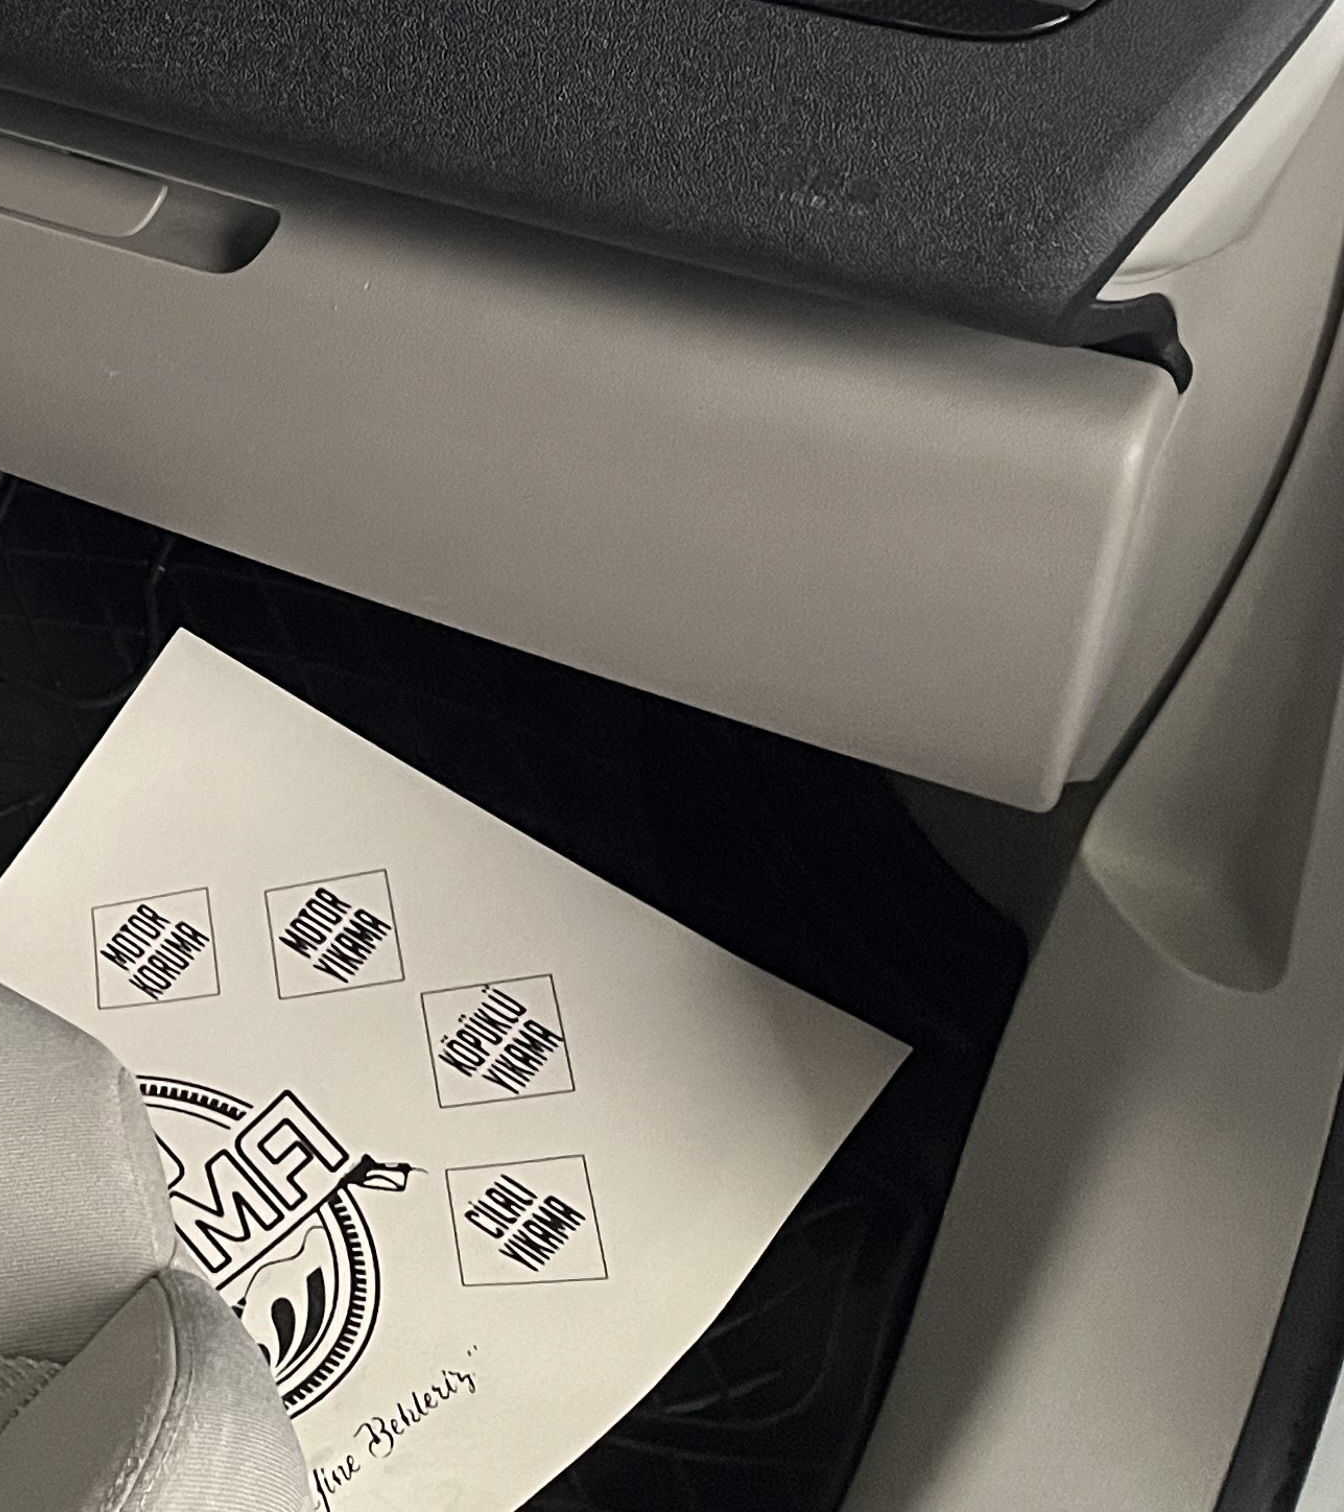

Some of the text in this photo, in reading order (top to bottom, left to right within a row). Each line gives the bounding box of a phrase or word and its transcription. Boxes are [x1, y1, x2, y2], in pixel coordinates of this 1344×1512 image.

[100, 904, 172, 971] MOTOR
[128, 921, 211, 1000] KORUMA
[278, 886, 353, 959] MOTOR
[313, 908, 393, 984] YIKAMA
[438, 984, 528, 1078] KÖPÜKLÜ
[481, 1019, 564, 1095] YIKAMA
[464, 1173, 538, 1239] CİLALI
[498, 1195, 587, 1273] YIKAMA
